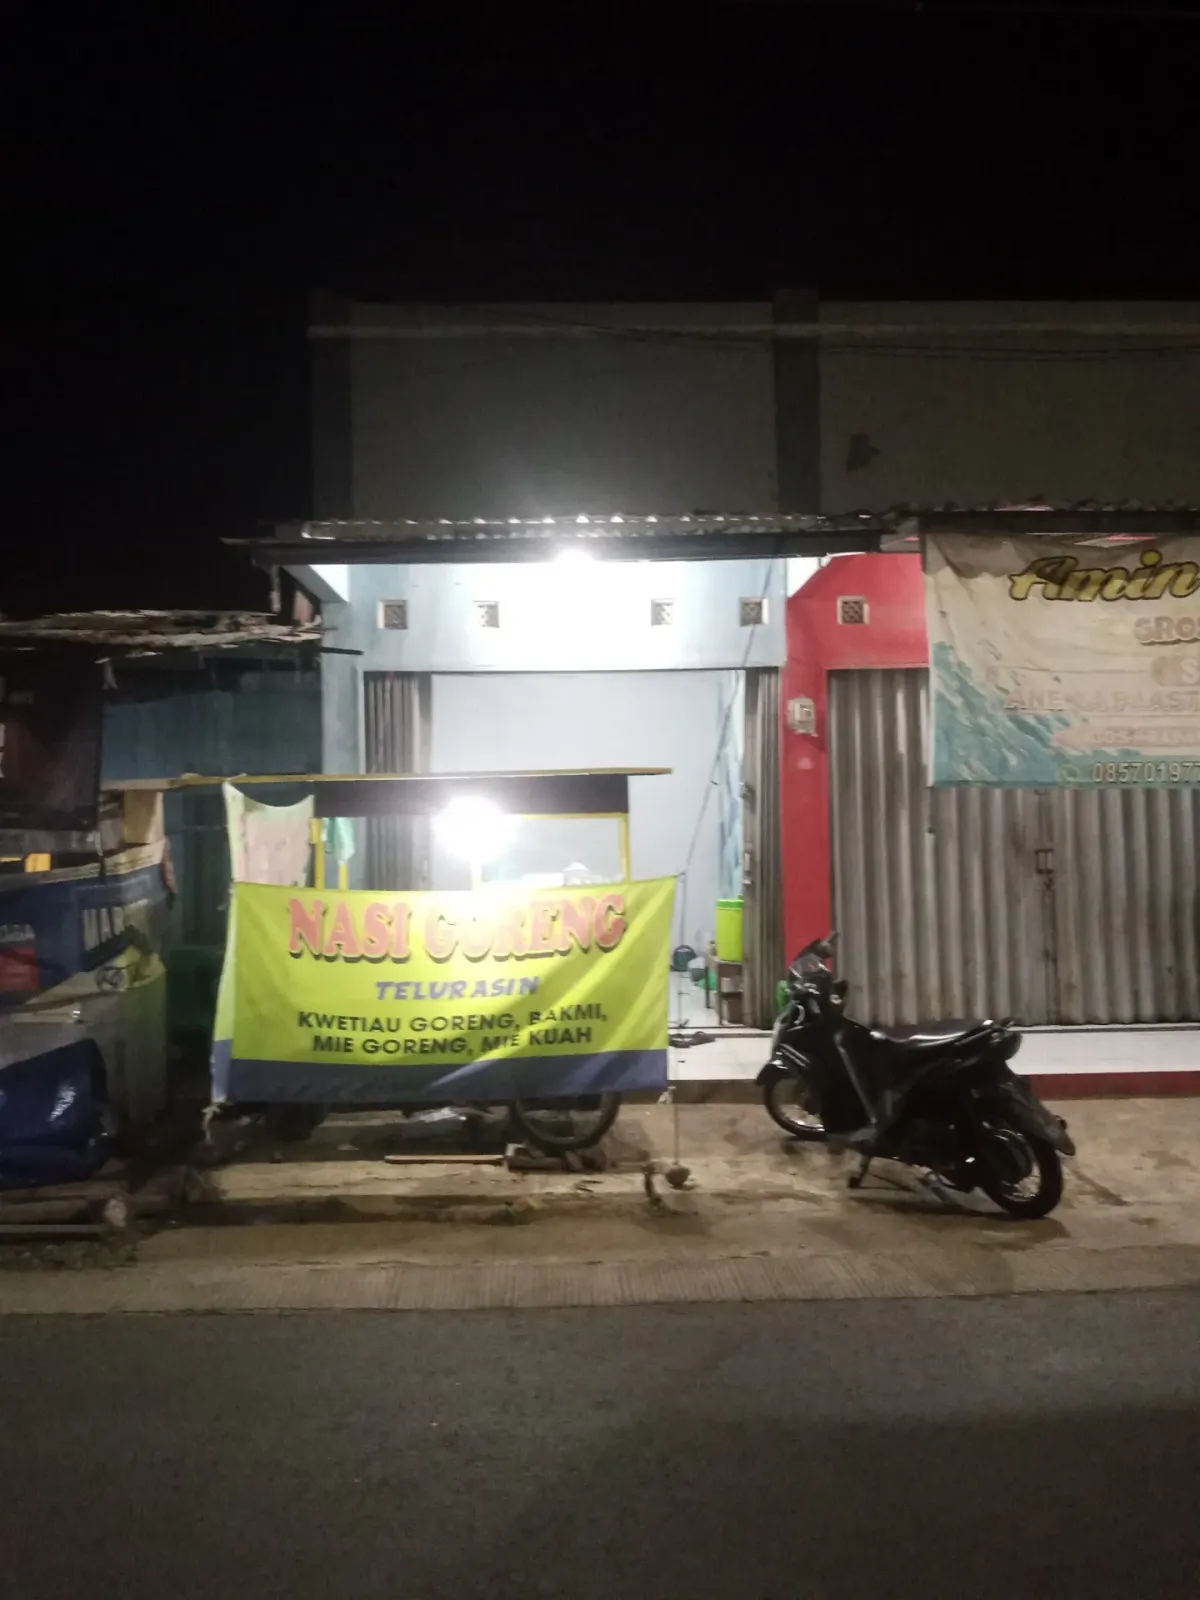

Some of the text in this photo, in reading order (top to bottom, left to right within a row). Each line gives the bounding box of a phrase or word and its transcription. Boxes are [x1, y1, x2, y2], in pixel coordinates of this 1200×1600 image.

[1008, 549, 1200, 602] Amin
[287, 893, 629, 963] NASI GORENG
[298, 1010, 401, 1034] KWETIAU
[313, 1035, 354, 1054] MIE
[481, 1033, 520, 1053] MIE
[529, 1026, 593, 1047] KUAH
